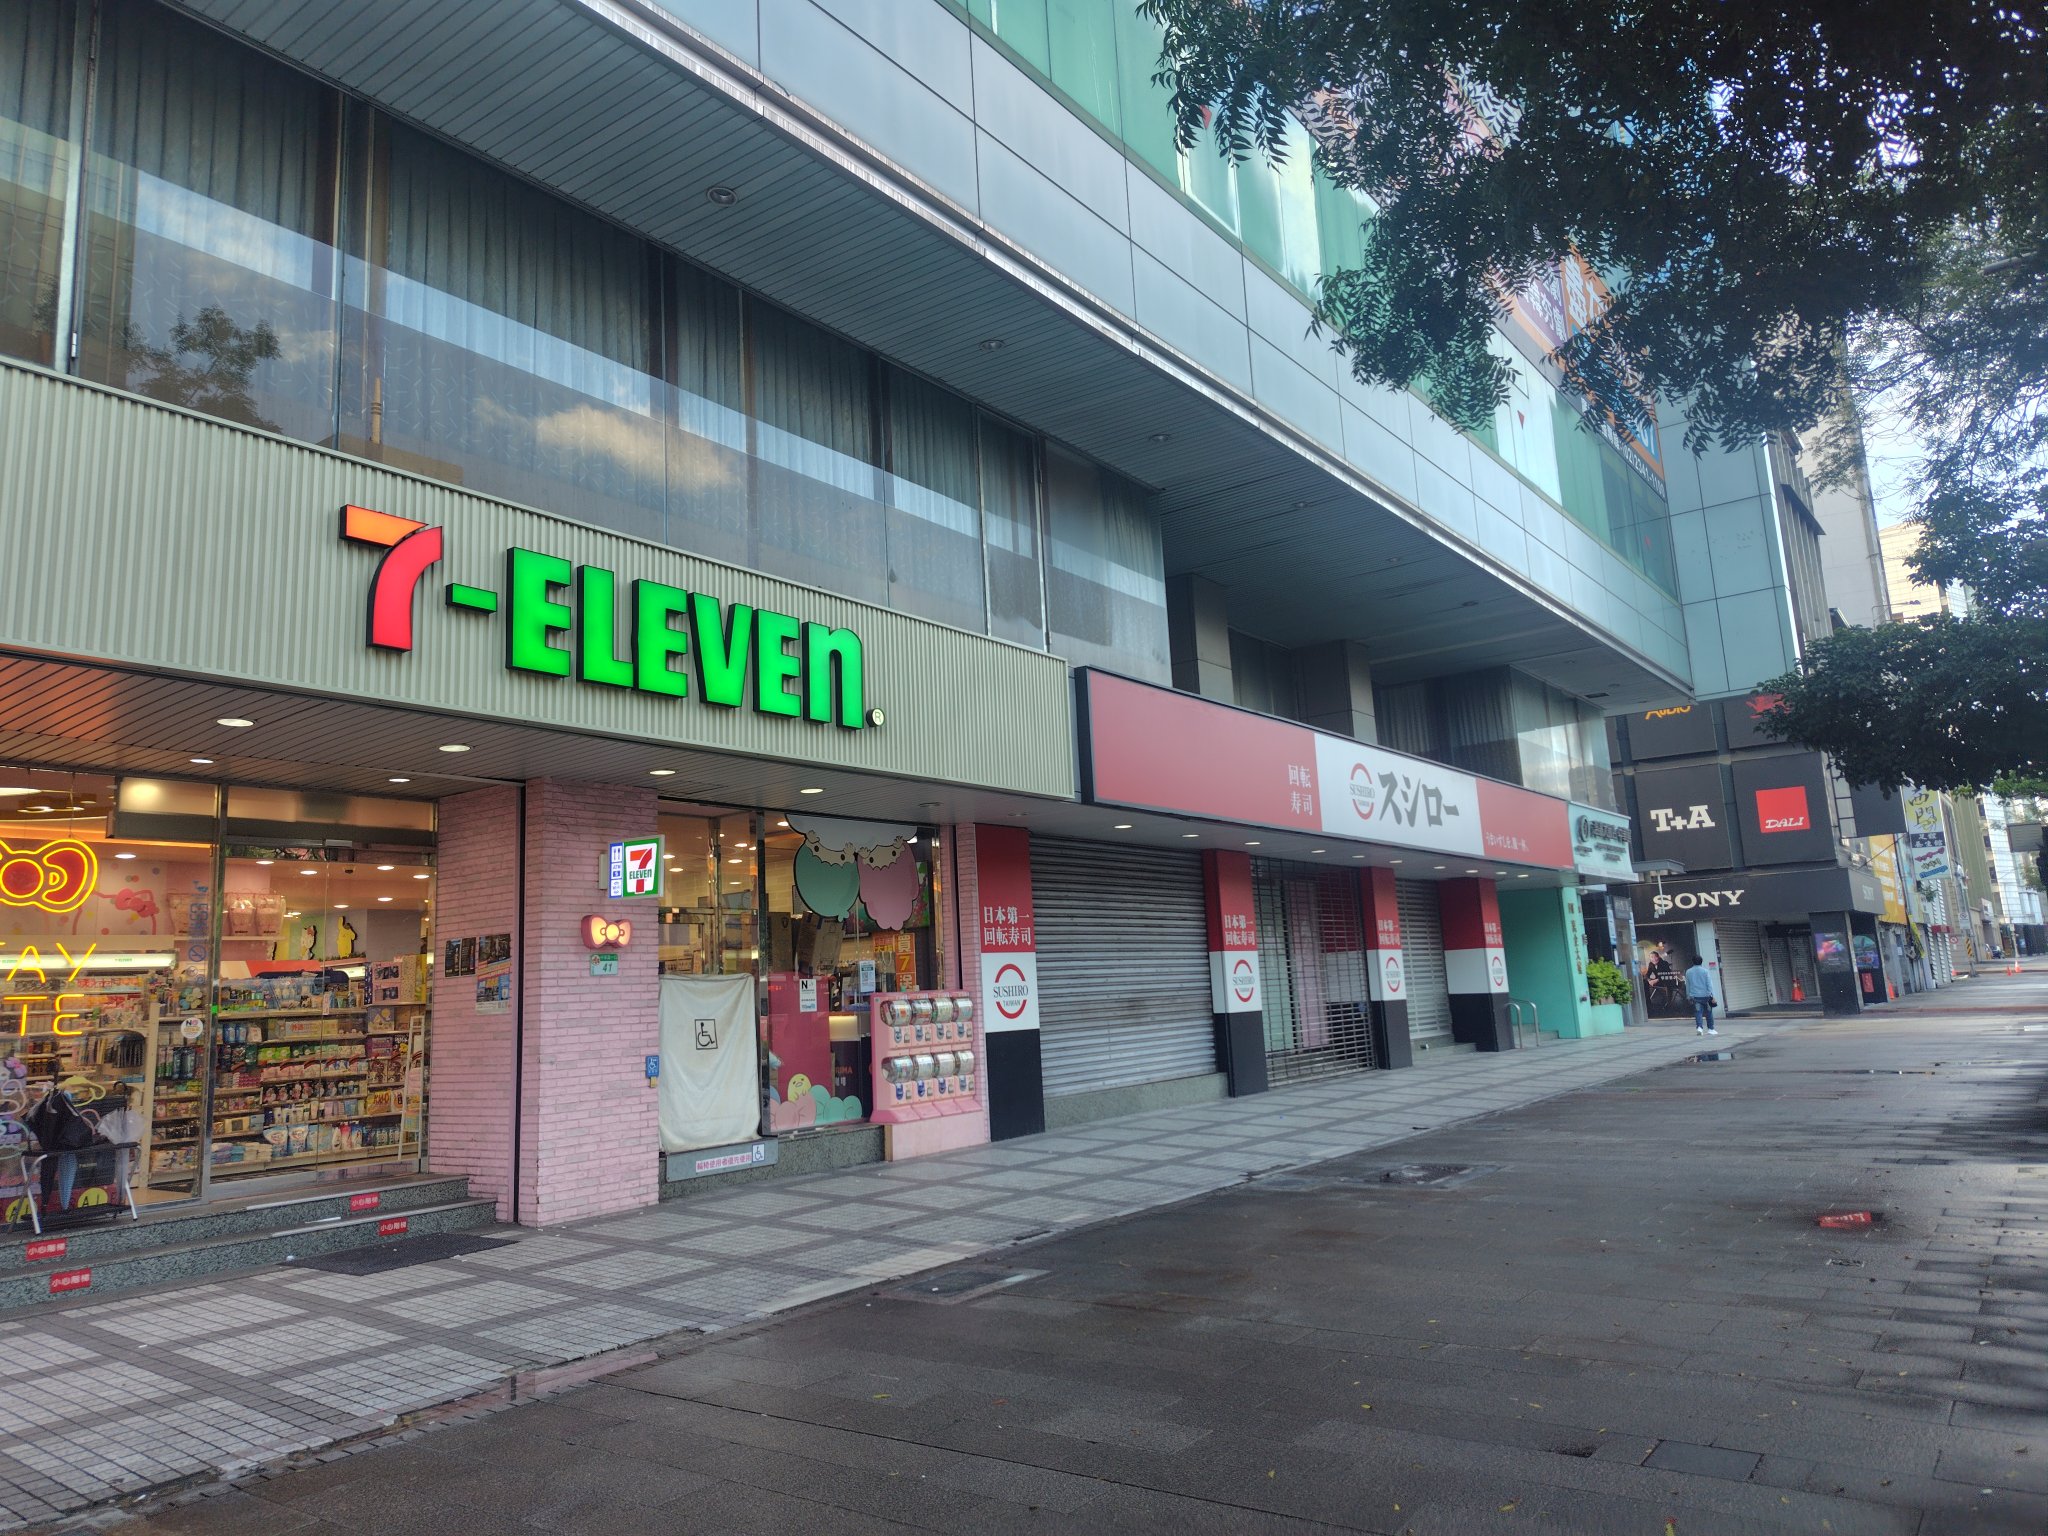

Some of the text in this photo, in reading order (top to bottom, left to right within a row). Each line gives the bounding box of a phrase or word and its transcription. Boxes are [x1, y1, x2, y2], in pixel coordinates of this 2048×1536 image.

[1288, 764, 1312, 788] 回転
[1349, 783, 1375, 799] SUSHIRO
[1377, 771, 1459, 828] スシロー
[1291, 791, 1313, 816] 寿司
[1650, 804, 1715, 832] T+A
[1765, 816, 1804, 829] DALI
[1653, 889, 1745, 910] SONY
[983, 905, 1030, 925] 日本第一
[1224, 914, 1254, 929] 日本第一
[983, 926, 1032, 946] 回転寿司
[1225, 930, 1256, 946] 回転寿司
[602, 962, 613, 973] 41
[993, 984, 1029, 998] SUSHIRO
